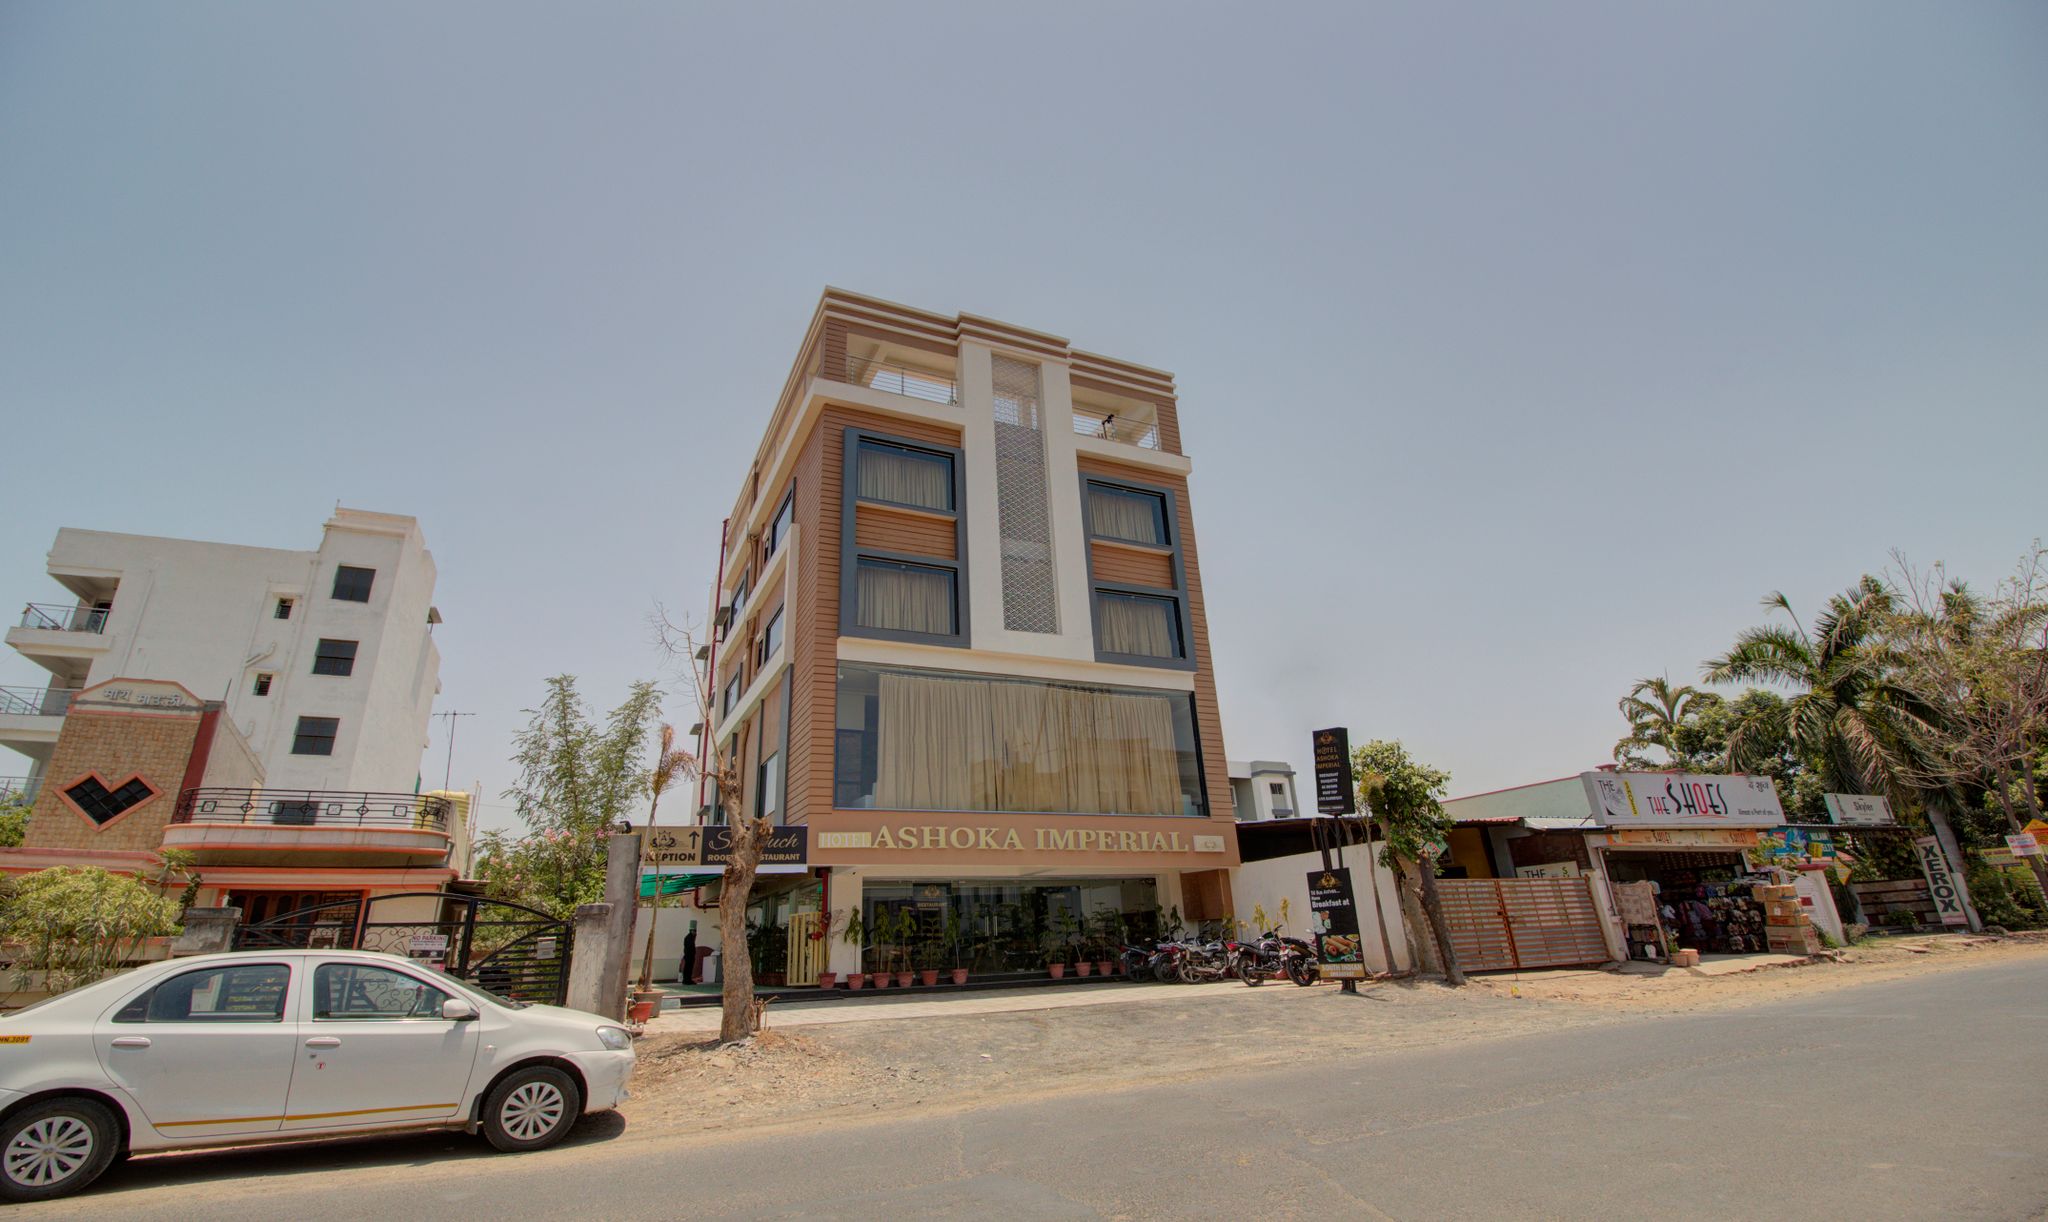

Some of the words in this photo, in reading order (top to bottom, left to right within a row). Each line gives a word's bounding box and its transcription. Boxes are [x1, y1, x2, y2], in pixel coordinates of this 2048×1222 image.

[1647, 796, 1671, 815] THE
[1665, 777, 1728, 815] SHOES
[820, 832, 871, 848] HOTEL
[873, 825, 1025, 850] ASHOKA
[1034, 828, 1189, 852] IMPERIAL
[1921, 845, 1960, 912] XEROX
[1312, 899, 1342, 908] Breakfast
[1342, 898, 1350, 906] at
